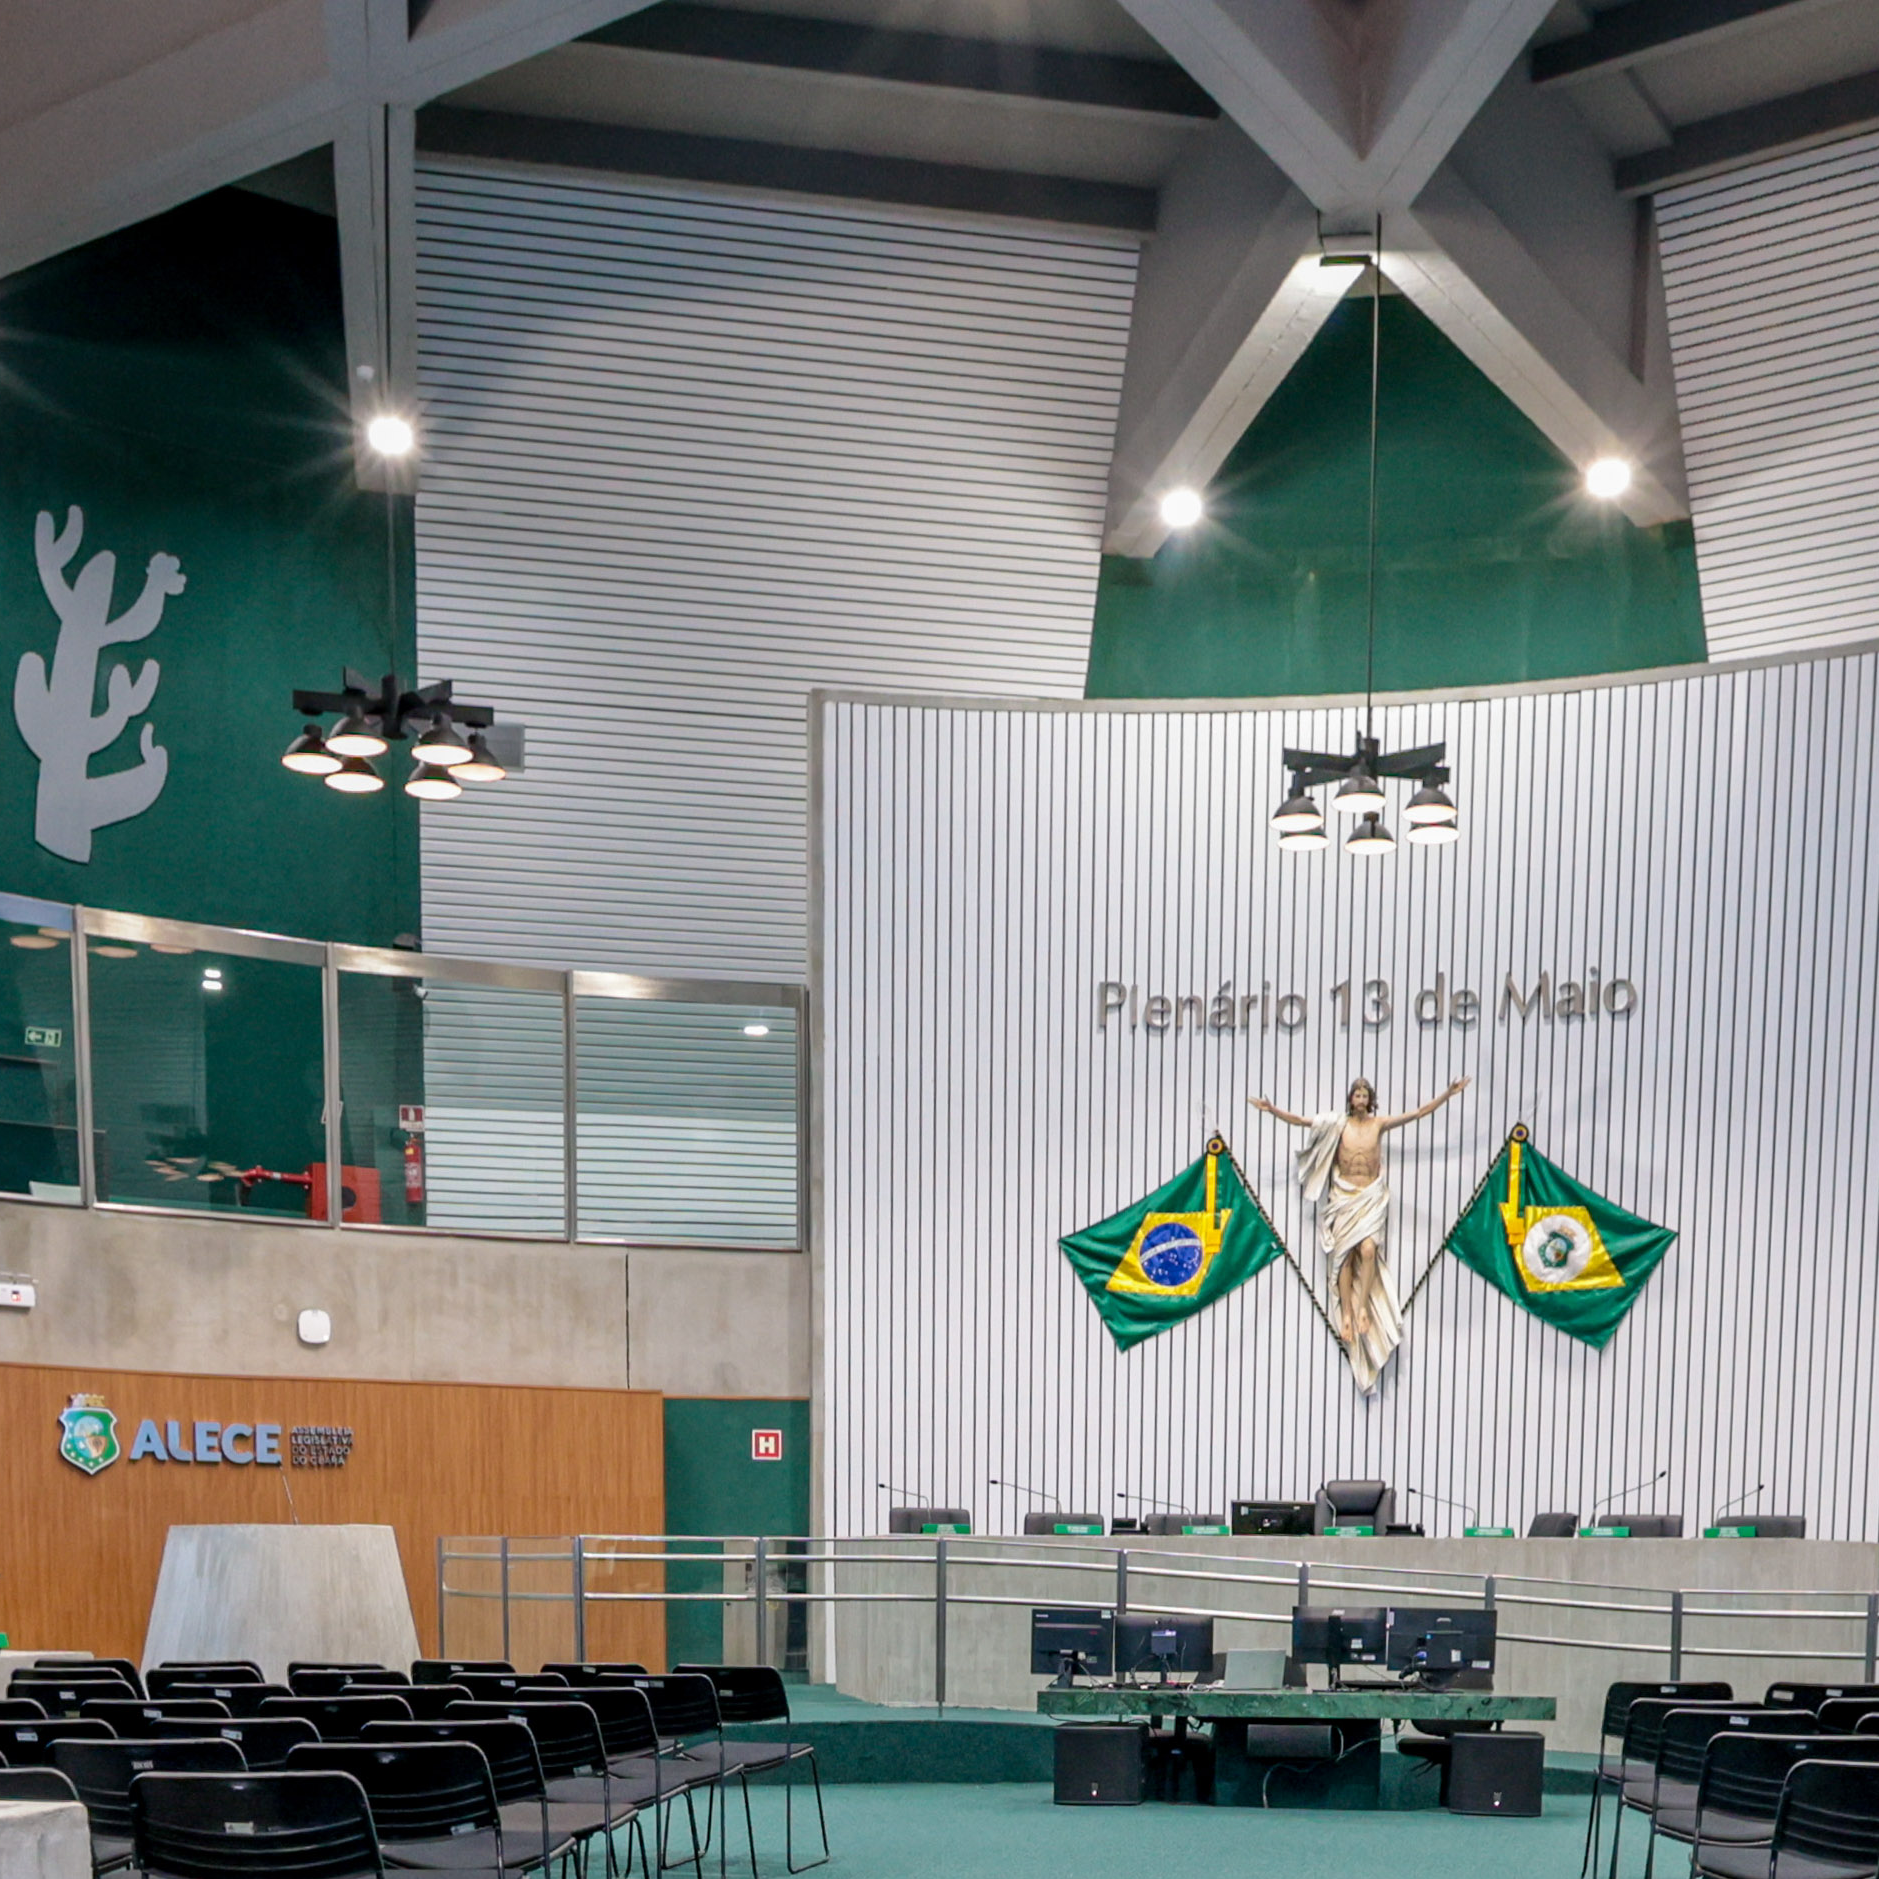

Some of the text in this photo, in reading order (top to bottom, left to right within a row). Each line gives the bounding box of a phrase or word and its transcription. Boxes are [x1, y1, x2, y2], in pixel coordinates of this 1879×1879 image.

[1096, 966, 1638, 1034] Plenário 13 de Maio
[129, 1419, 282, 1464] ALECE
[759, 1436, 775, 1454] H
